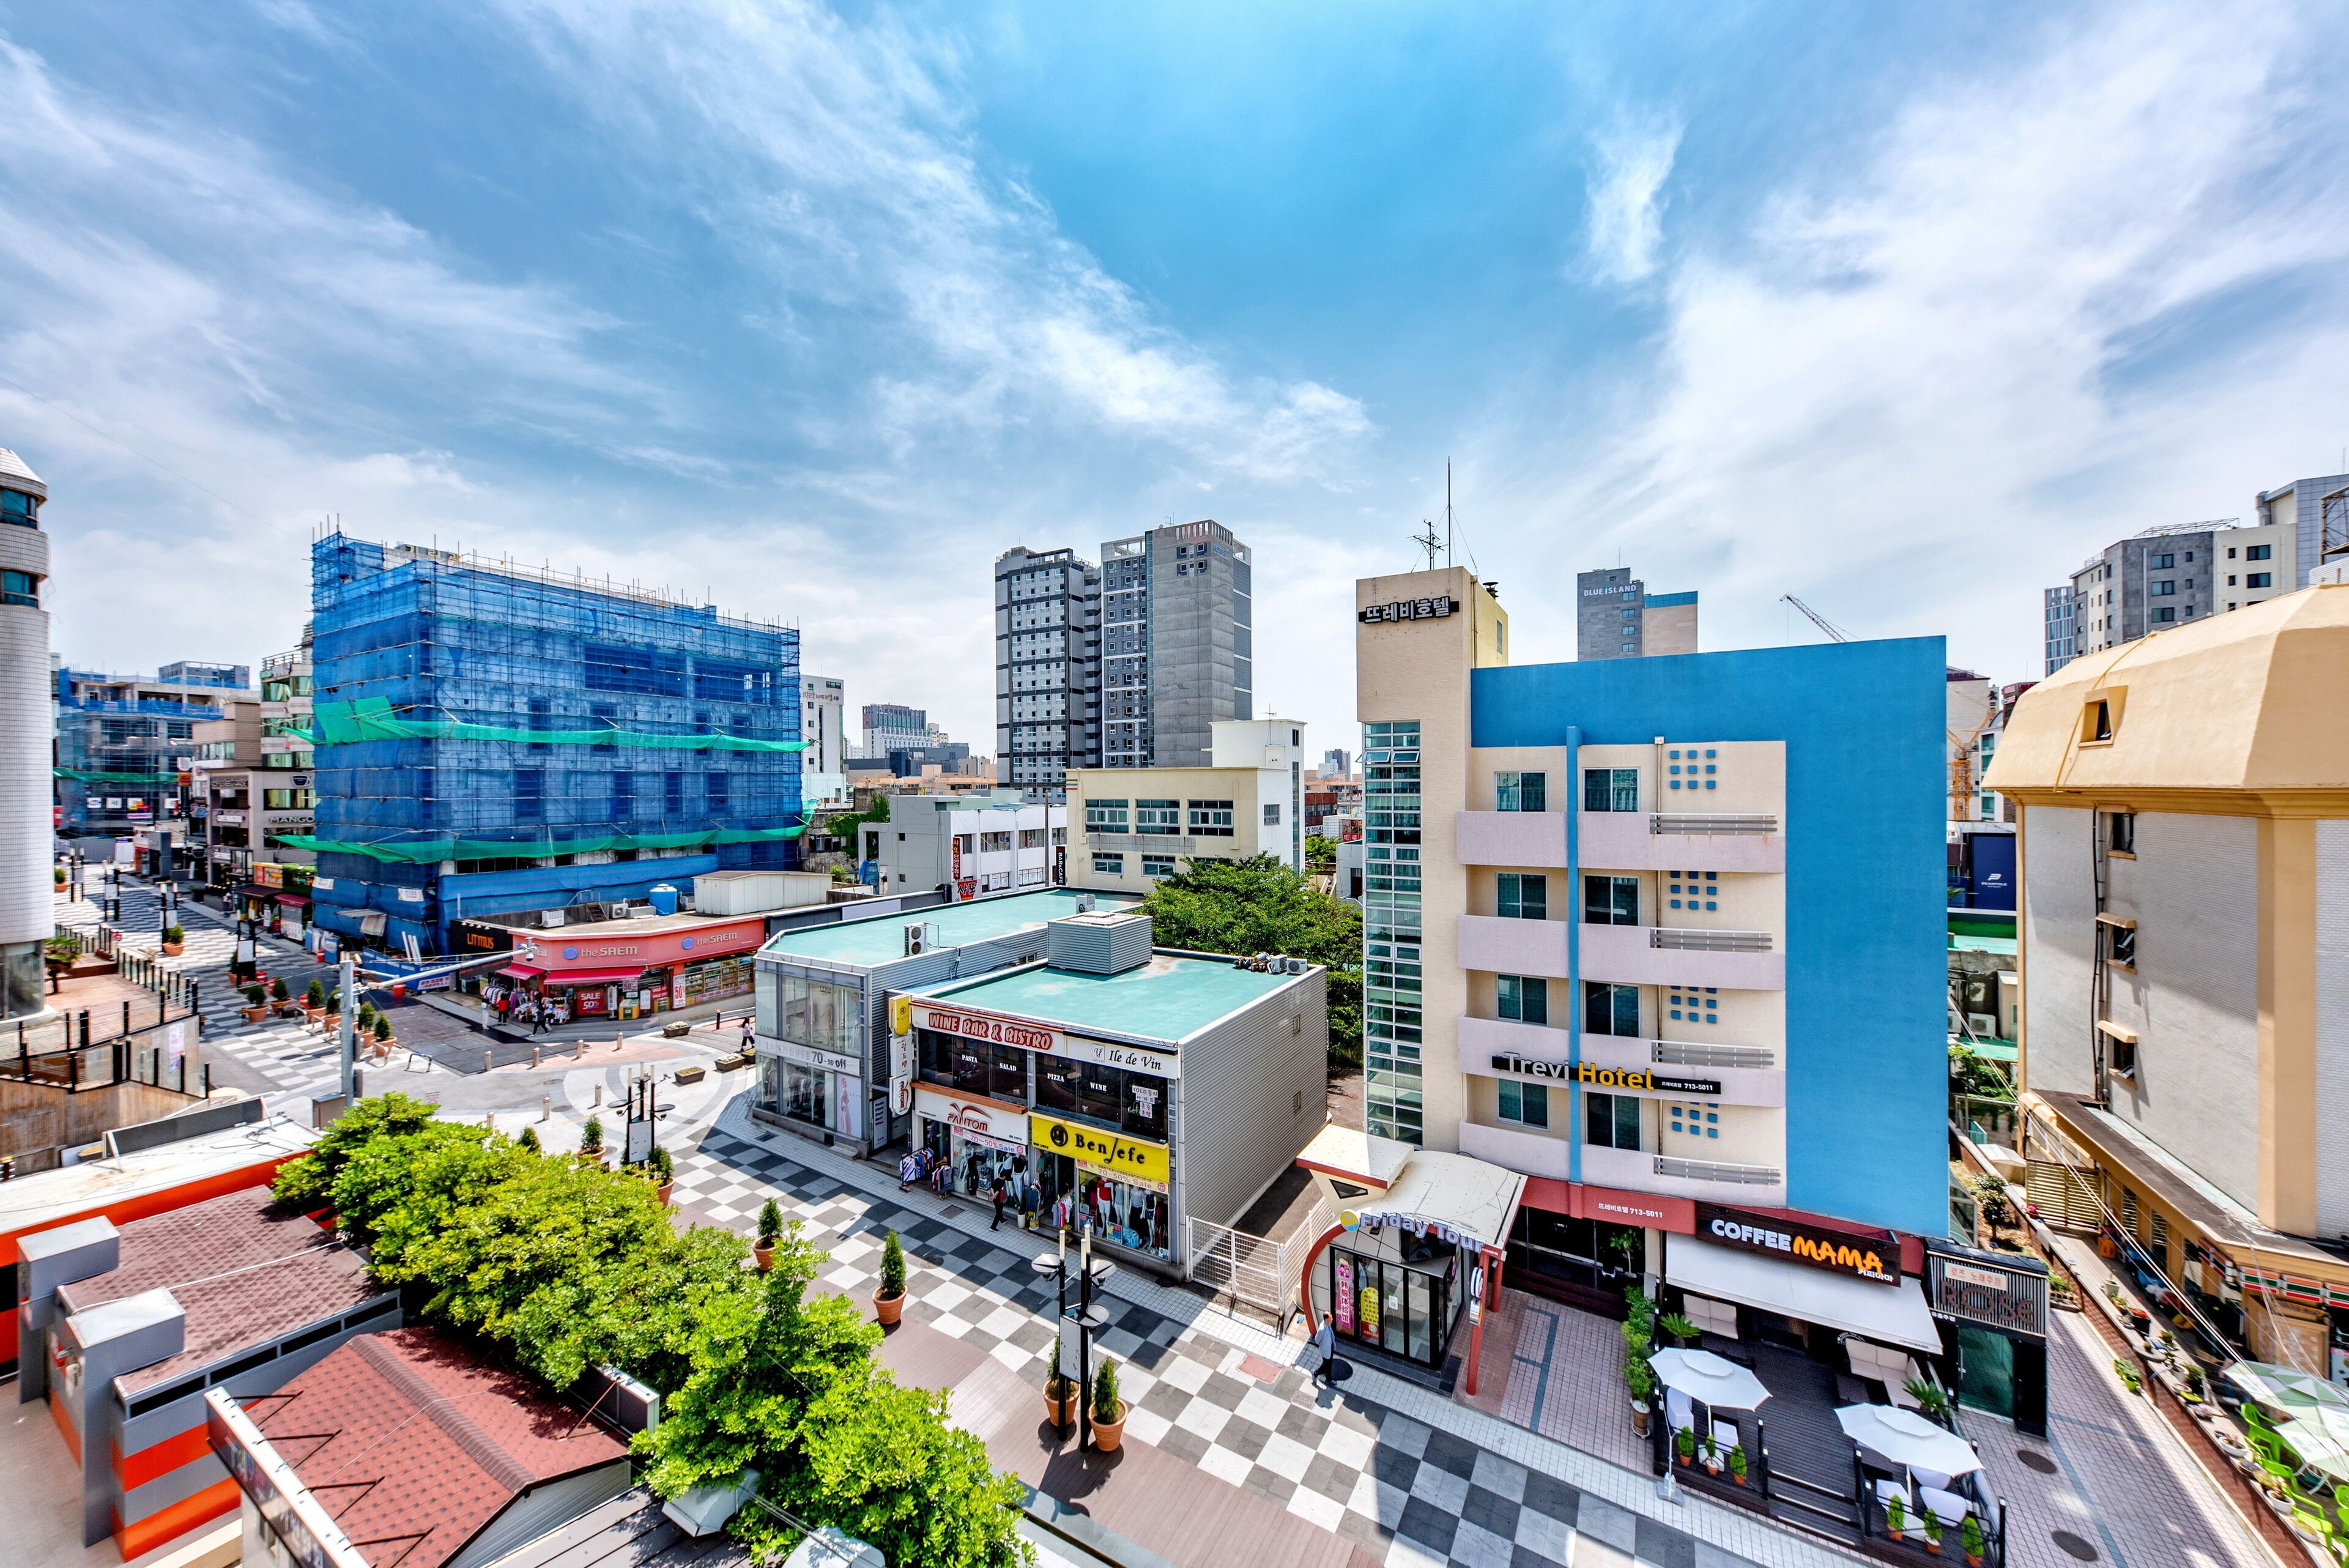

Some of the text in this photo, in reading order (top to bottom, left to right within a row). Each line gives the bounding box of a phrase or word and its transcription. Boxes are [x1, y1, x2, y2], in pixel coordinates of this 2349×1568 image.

[1584, 585, 1637, 596] BLUE ISLAND
[1365, 596, 1450, 623] 뜨레비호텔
[957, 883, 976, 895] 샤또
[467, 933, 494, 949] LITMUS
[696, 932, 738, 946] the SAEM
[581, 946, 638, 957] the SAEM
[929, 1013, 1053, 1050] WINE BAR & BISTRO
[835, 1058, 847, 1069] off
[962, 1054, 978, 1063] PASTA
[1108, 1050, 1161, 1071] Ile de Vin
[999, 1063, 1017, 1072] SALAD
[1504, 1051, 1570, 1080] Trevi
[1578, 1061, 1655, 1091] Hotel
[1683, 1082, 1713, 1091] 713-5011
[1047, 1072, 1064, 1082] PIZZA
[1089, 1082, 1107, 1092] WINE
[947, 1113, 988, 1131] FANTOM
[998, 1143, 1015, 1153] Sale
[1133, 1176, 1152, 1189] Sale
[1598, 1203, 1663, 1218] 뜨레비호텔 713-5011
[1360, 1211, 1486, 1254] Friday Tour
[1711, 1219, 1883, 1275] COFFEE MAMA
[1857, 1268, 1894, 1282] 커피마마
[1951, 1267, 2002, 1287] 로즈 노래주점
[1940, 1280, 2035, 1327] ROSE
